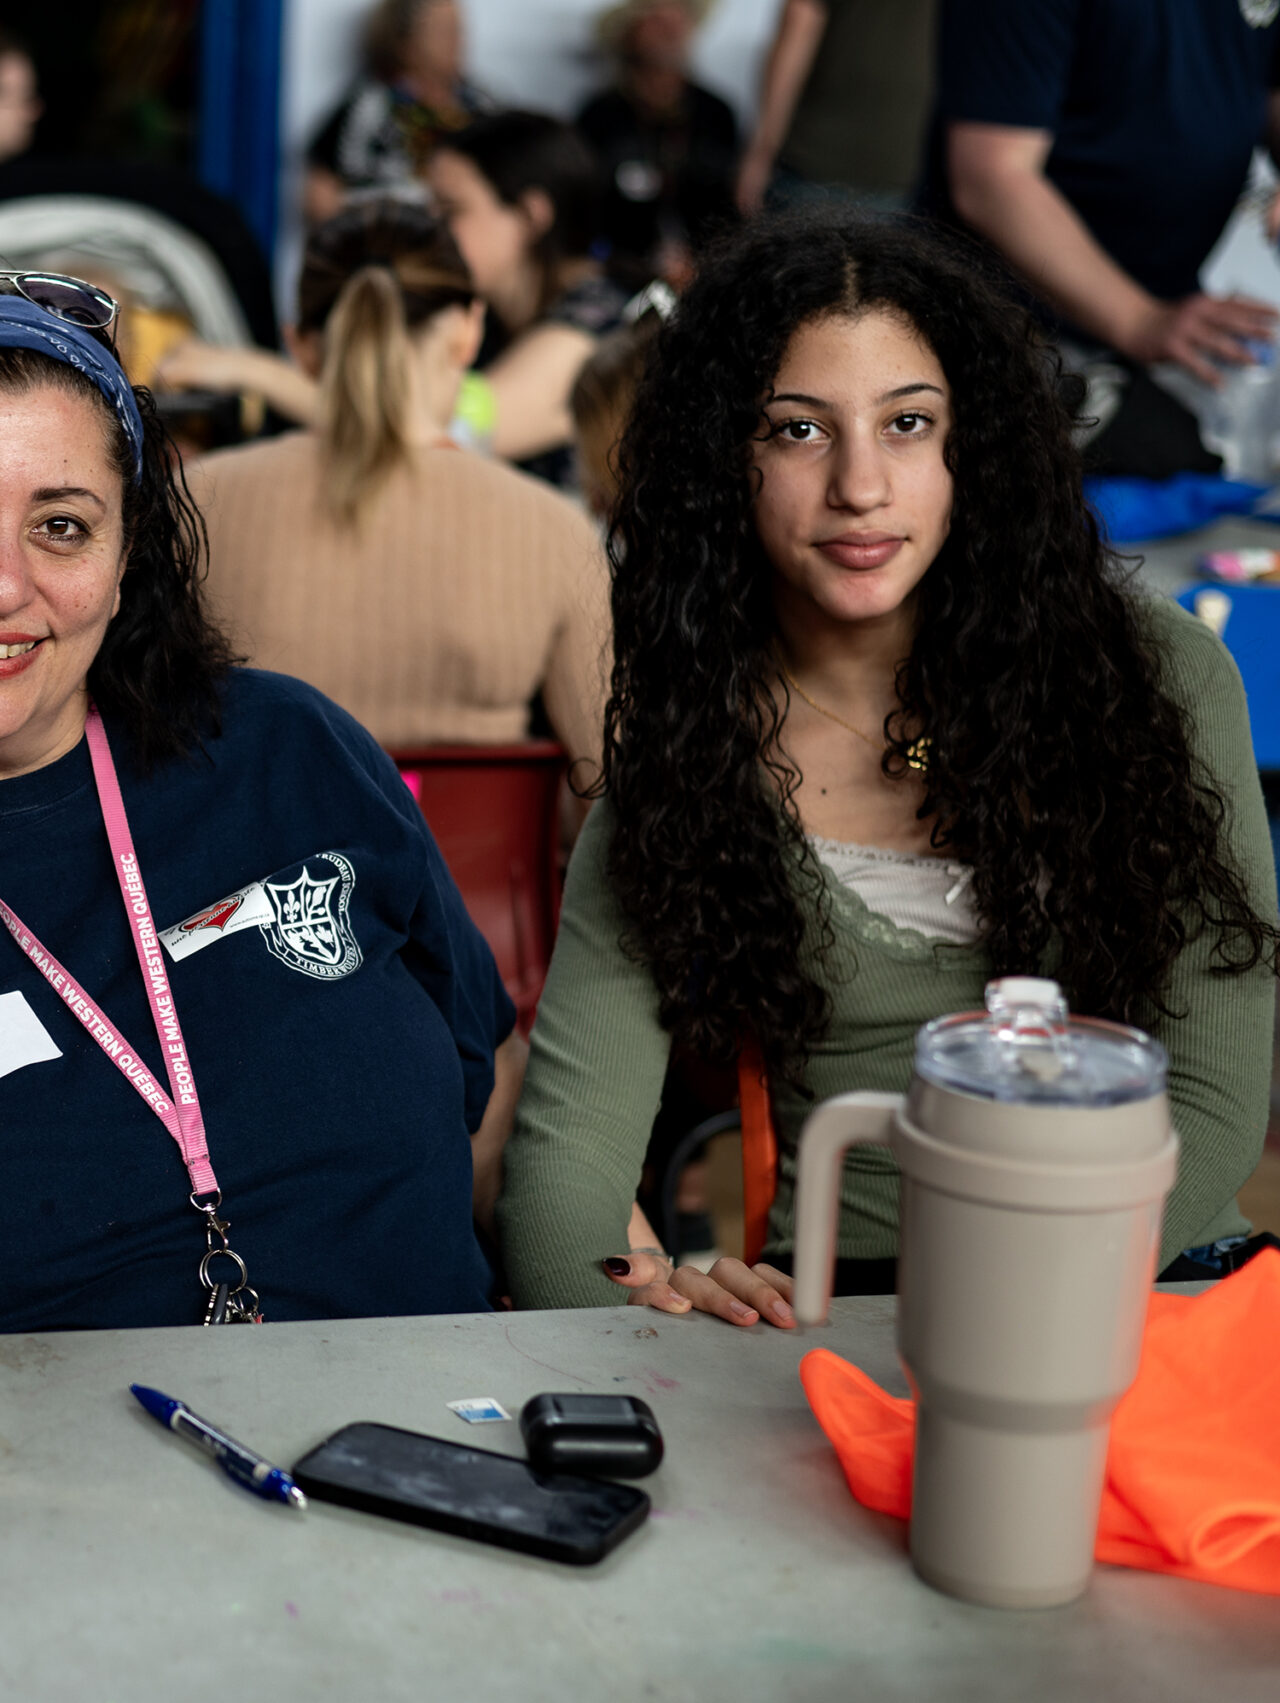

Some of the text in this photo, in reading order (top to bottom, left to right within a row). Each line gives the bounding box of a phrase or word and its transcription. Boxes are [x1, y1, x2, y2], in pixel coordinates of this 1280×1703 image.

[29, 946, 66, 989] MAKE
[62, 982, 124, 1058] WESTERN
[118, 1054, 169, 1113] QUÉBEC
[120, 852, 196, 1105] PEOPLE MAKE WESTERN QUÉBEC
